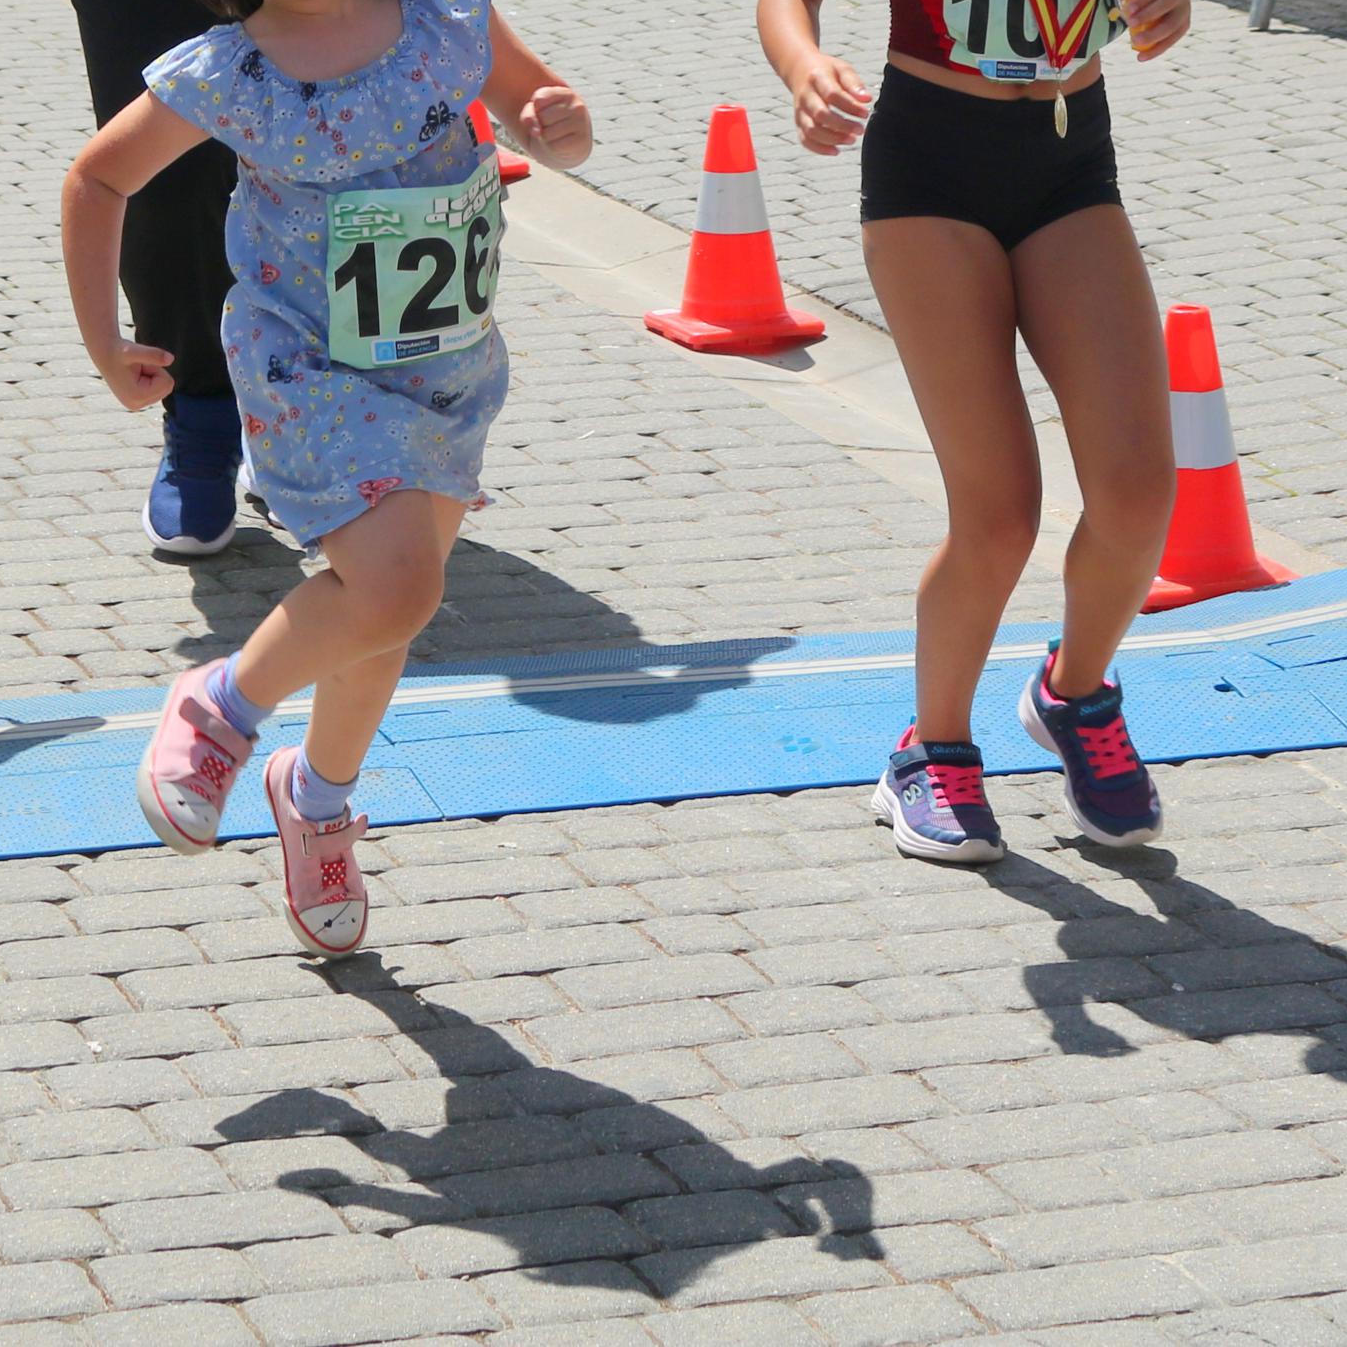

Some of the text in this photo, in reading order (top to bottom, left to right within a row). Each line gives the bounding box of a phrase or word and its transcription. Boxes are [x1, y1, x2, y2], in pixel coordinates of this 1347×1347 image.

[334, 202, 389, 214] PA
[334, 213, 401, 227] LEN
[335, 225, 404, 240] CIA
